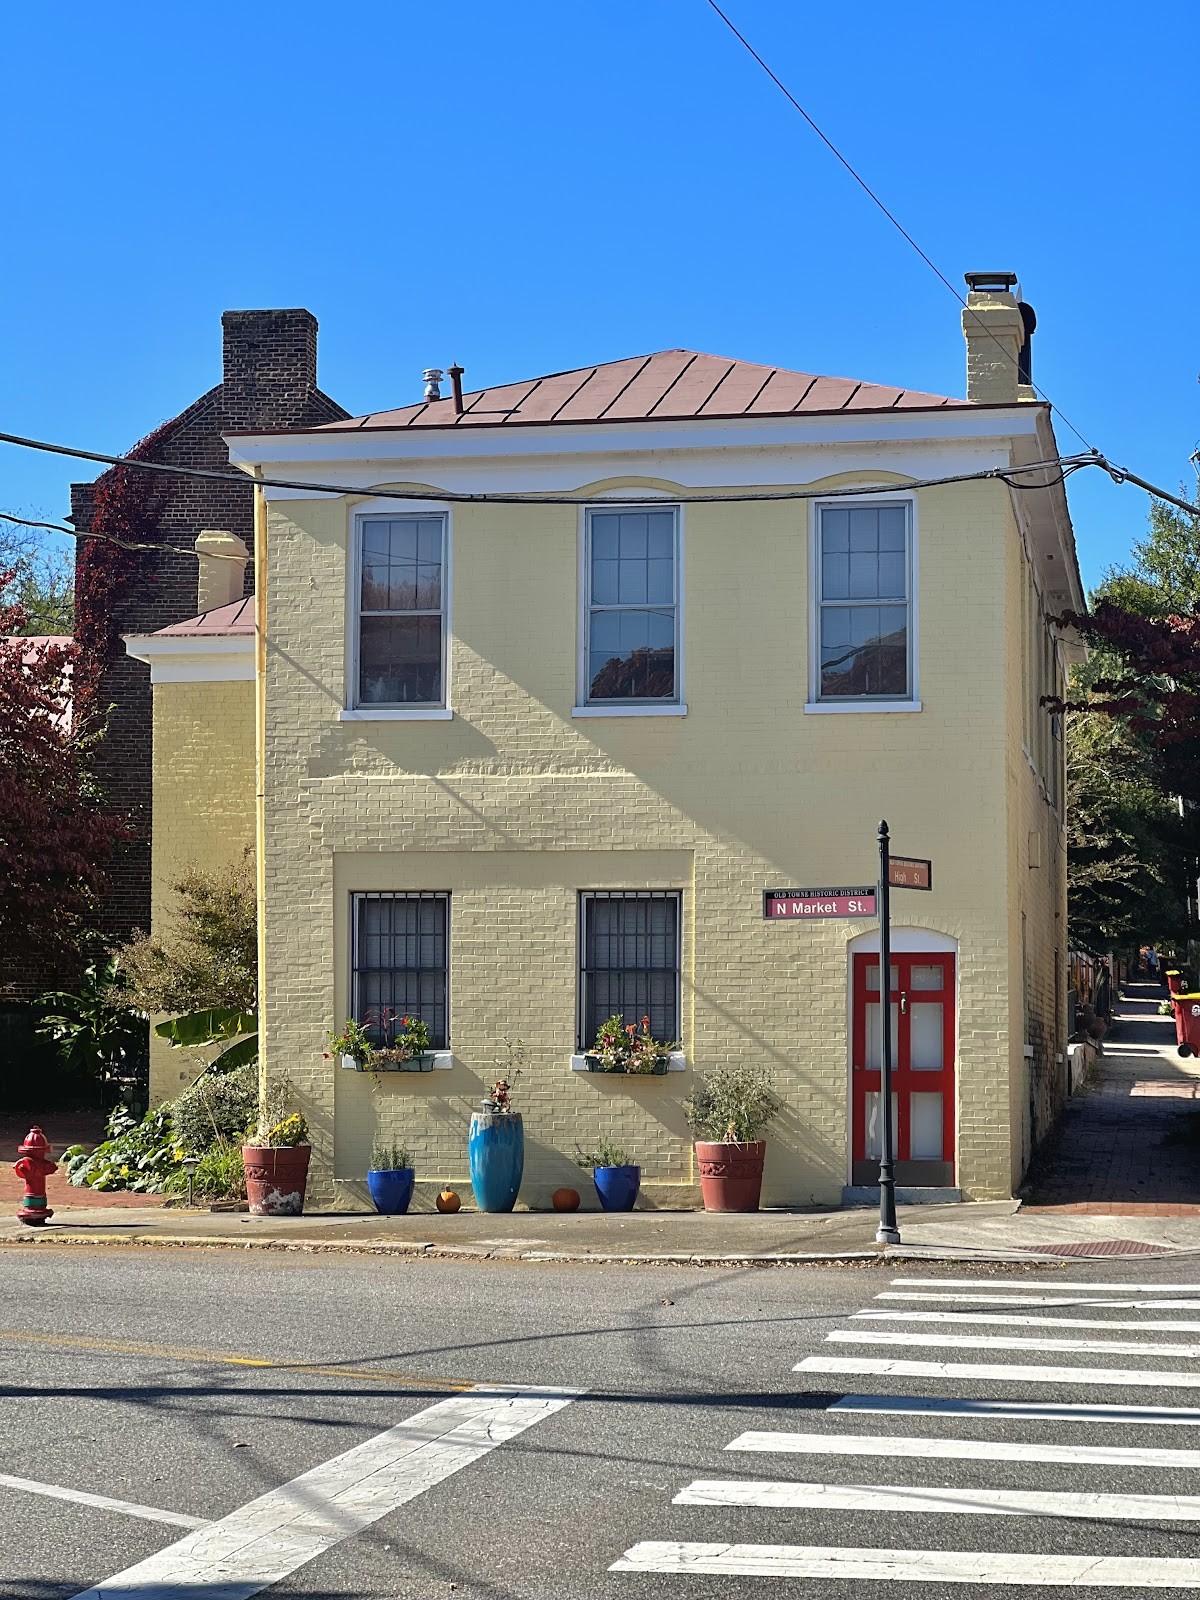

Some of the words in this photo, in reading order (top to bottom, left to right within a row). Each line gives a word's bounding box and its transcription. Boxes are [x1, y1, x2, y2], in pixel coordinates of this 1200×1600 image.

[894, 870, 907, 885] High
[913, 872, 922, 885] St.
[776, 903, 787, 915] N
[792, 901, 838, 914] Market
[848, 900, 867, 912] St.
